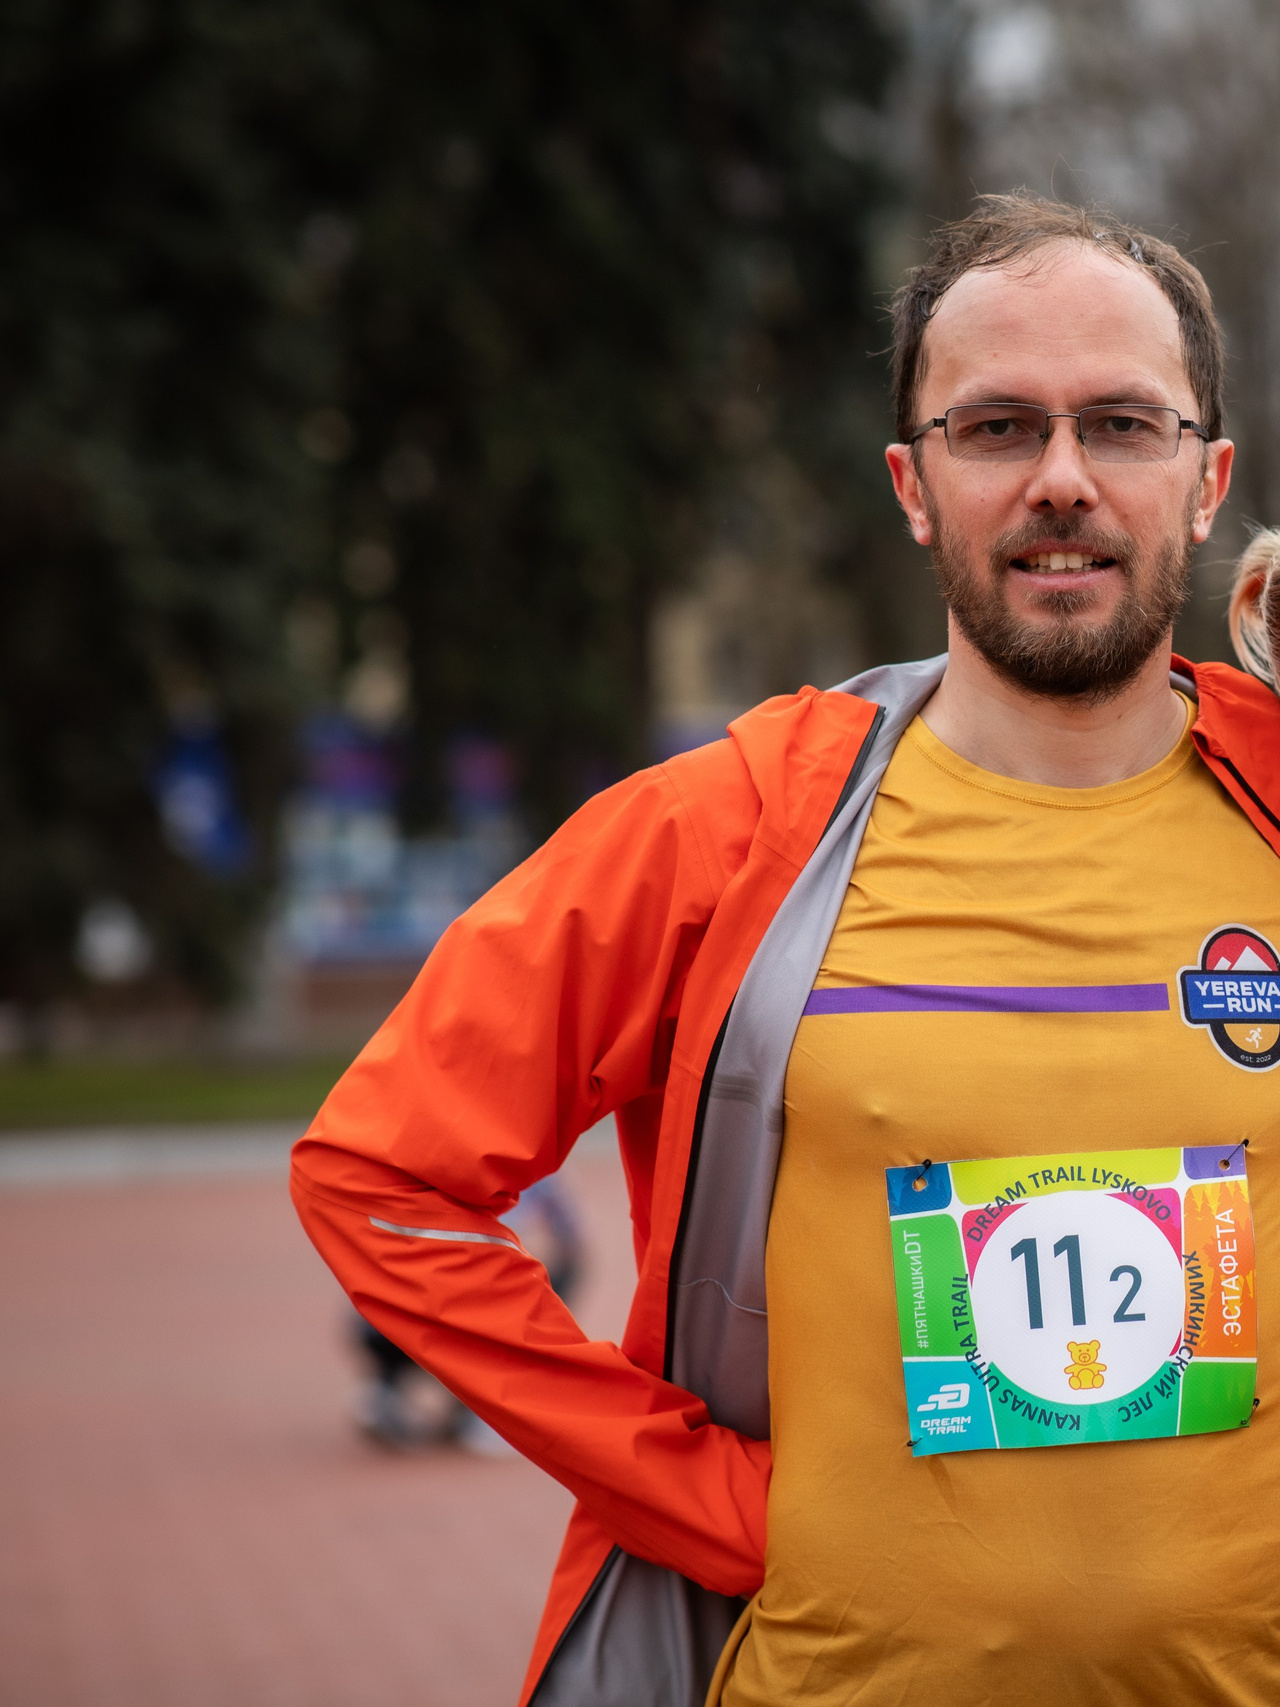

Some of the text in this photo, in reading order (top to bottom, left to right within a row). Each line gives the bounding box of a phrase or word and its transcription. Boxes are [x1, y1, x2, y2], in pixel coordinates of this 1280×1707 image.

[1226, 997, 1273, 1013] RUN
[1256, 1054, 1272, 1063] 2022
[967, 1166, 1172, 1243] DREAM TRAIL LYSKOVO
[1010, 1234, 1146, 1330] 11 2
[1215, 1208, 1242, 1336] ЭСТАФЕТА
[951, 1273, 970, 1332] TRAIL
[1117, 1250, 1206, 1423] ХИМКИНСКИЙ ЛЕС
[920, 1416, 972, 1429] DREAM
[927, 1425, 968, 1436] TRAIL
[998, 1389, 1081, 1431] KANNAS
